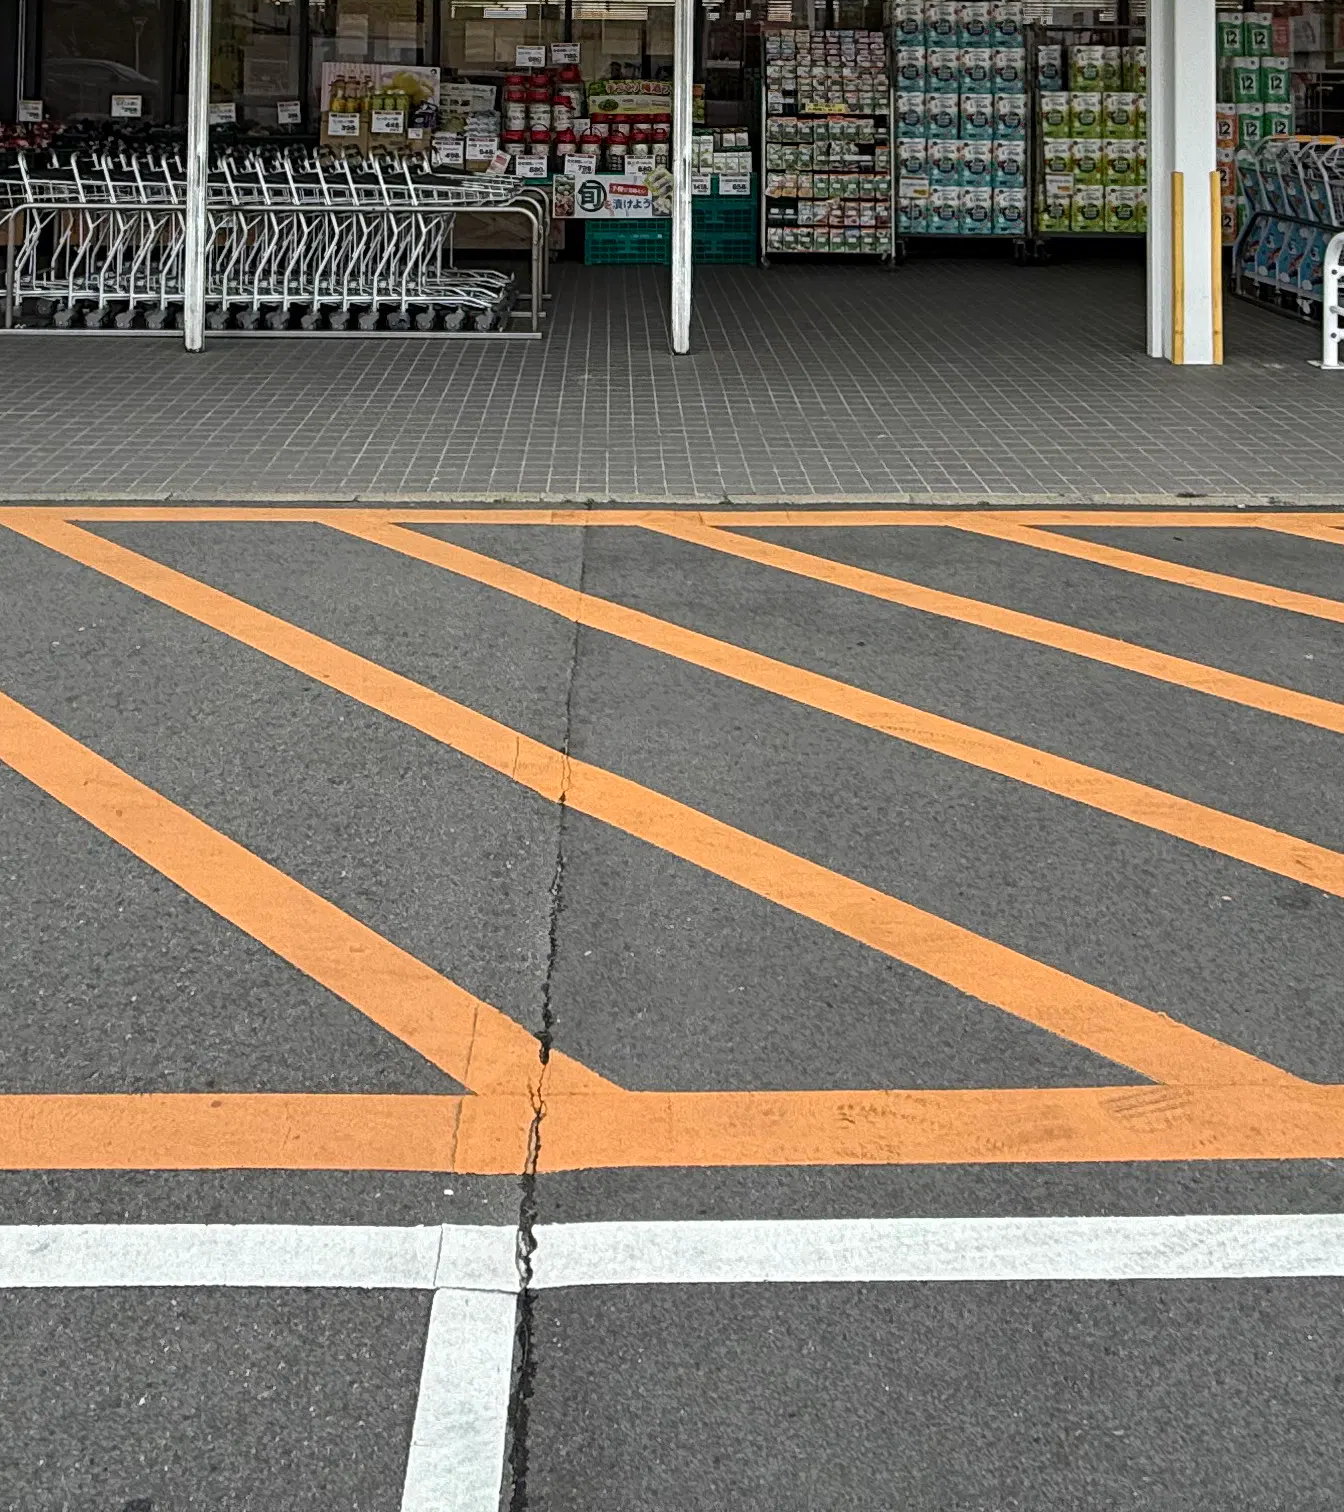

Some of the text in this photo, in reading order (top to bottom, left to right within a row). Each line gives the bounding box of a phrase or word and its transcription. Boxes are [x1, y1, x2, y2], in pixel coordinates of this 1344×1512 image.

[1225, 30, 1238, 45] 12
[1254, 31, 1266, 45] 12
[1241, 75, 1254, 91] 12
[1271, 75, 1283, 90] 12
[1219, 121, 1231, 137] 12
[1246, 122, 1258, 137] 12
[1275, 120, 1287, 135] 12
